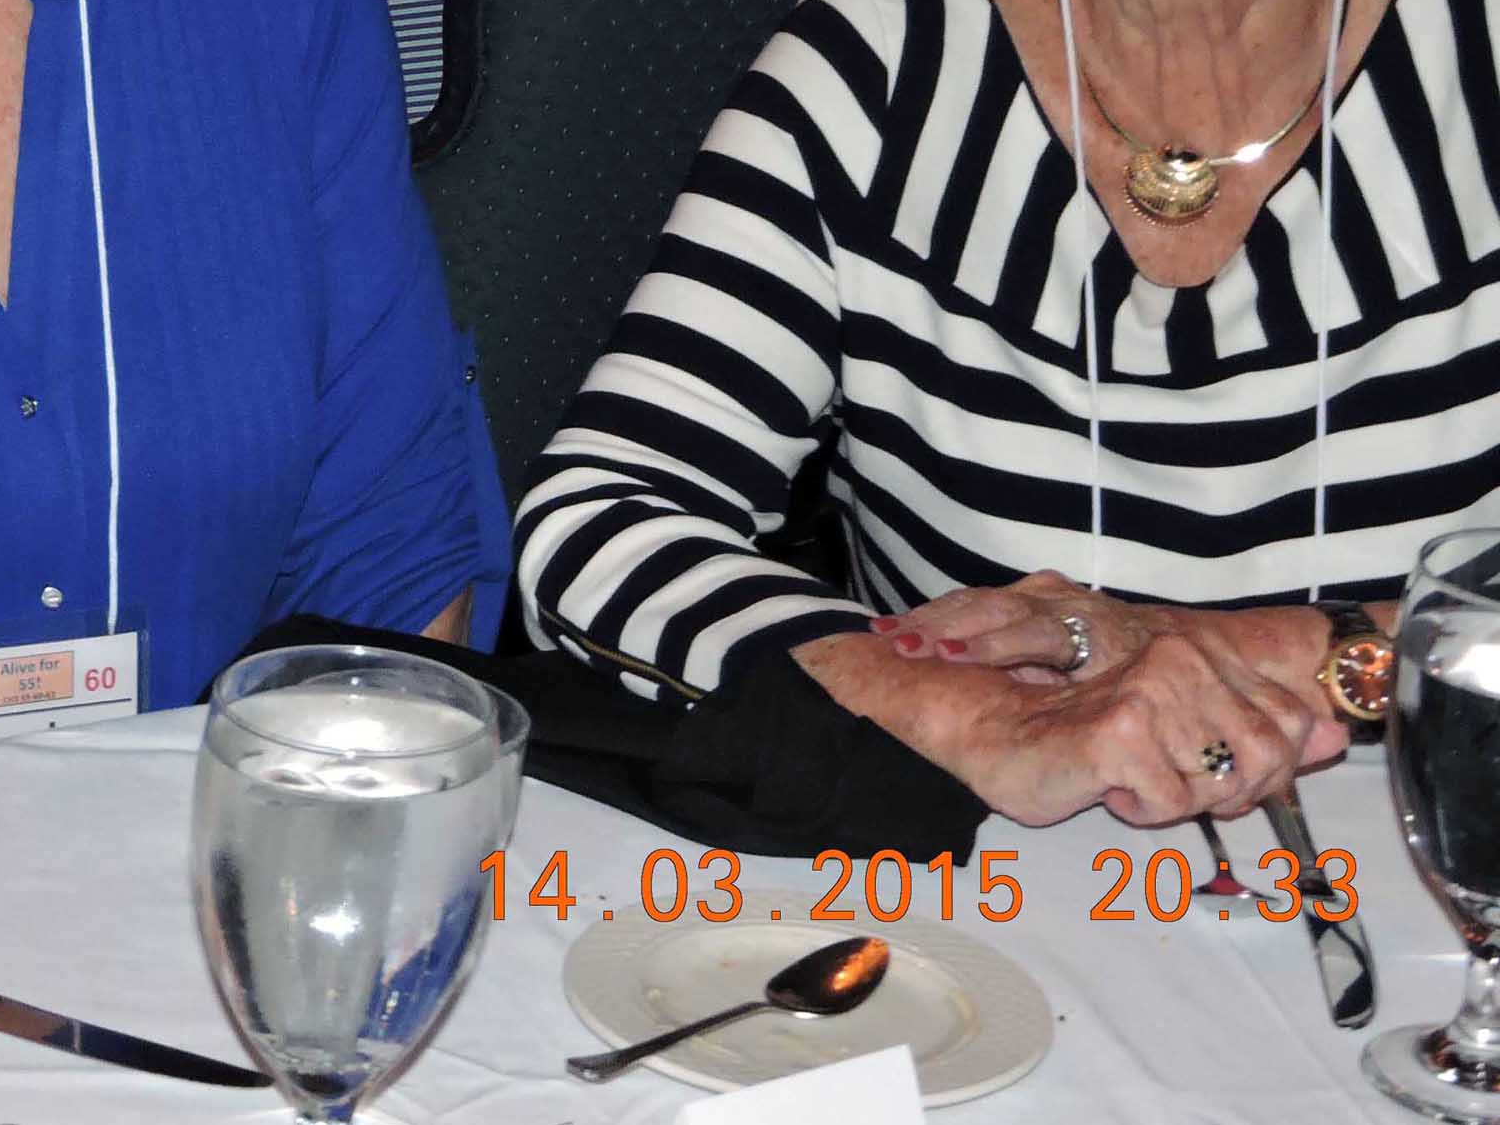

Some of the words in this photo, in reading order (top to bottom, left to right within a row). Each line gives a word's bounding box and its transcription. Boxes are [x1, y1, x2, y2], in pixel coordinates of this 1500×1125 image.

[2, 660, 36, 675] Alive
[40, 658, 60, 671] for
[84, 666, 116, 692] 60
